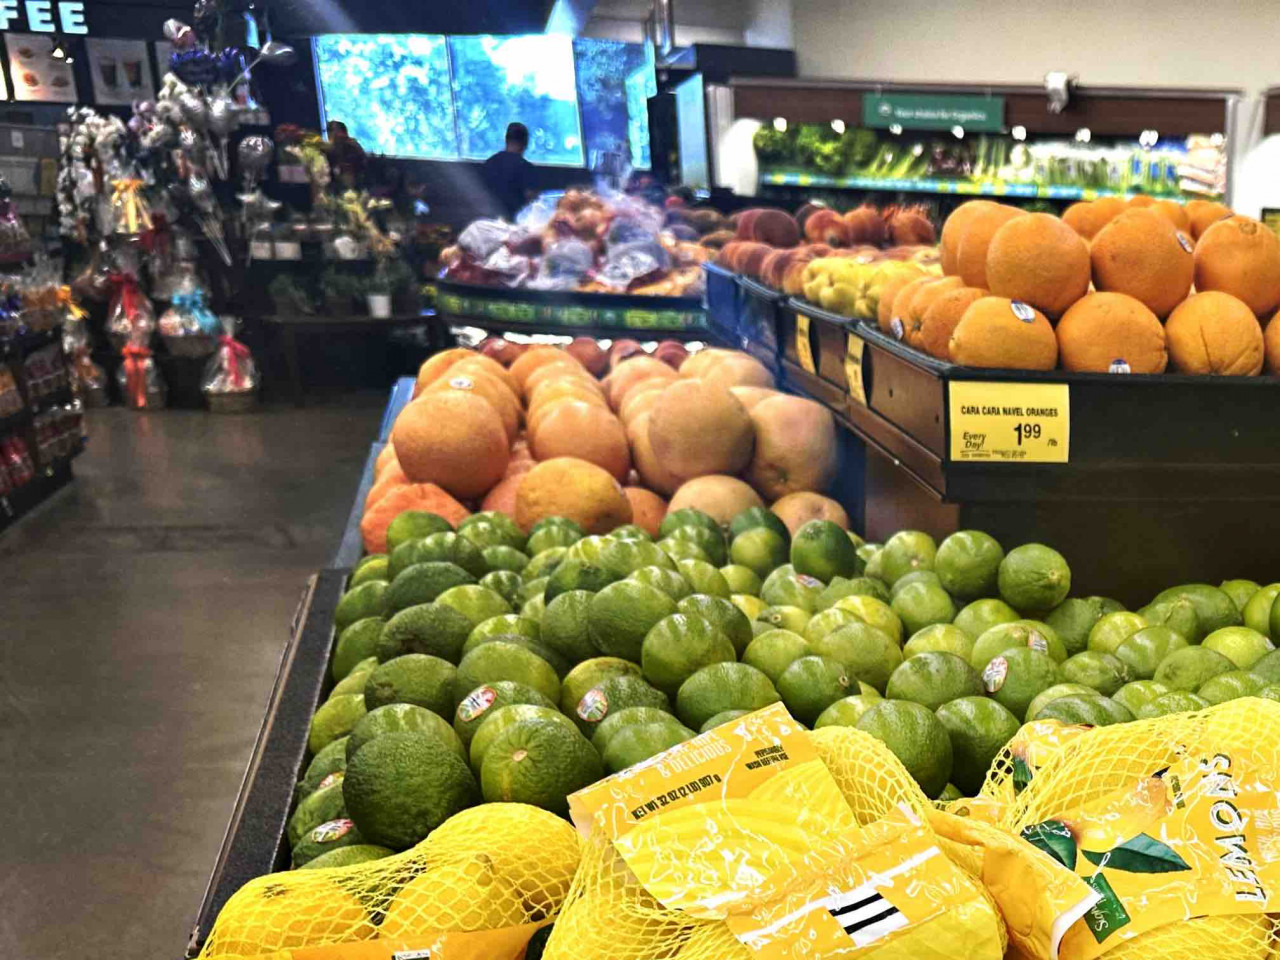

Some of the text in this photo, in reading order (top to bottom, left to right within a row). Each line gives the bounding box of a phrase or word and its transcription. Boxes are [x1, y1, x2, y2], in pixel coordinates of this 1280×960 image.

[961, 405, 1059, 418] CARA CARA NAVEL ORANGES
[962, 431, 987, 444] Every
[670, 738, 732, 774] DELICIOUS
[656, 794, 671, 807] 32
[666, 790, 681, 802] OZ
[698, 774, 714, 788] 907
[1200, 752, 1267, 903] LEMONS
